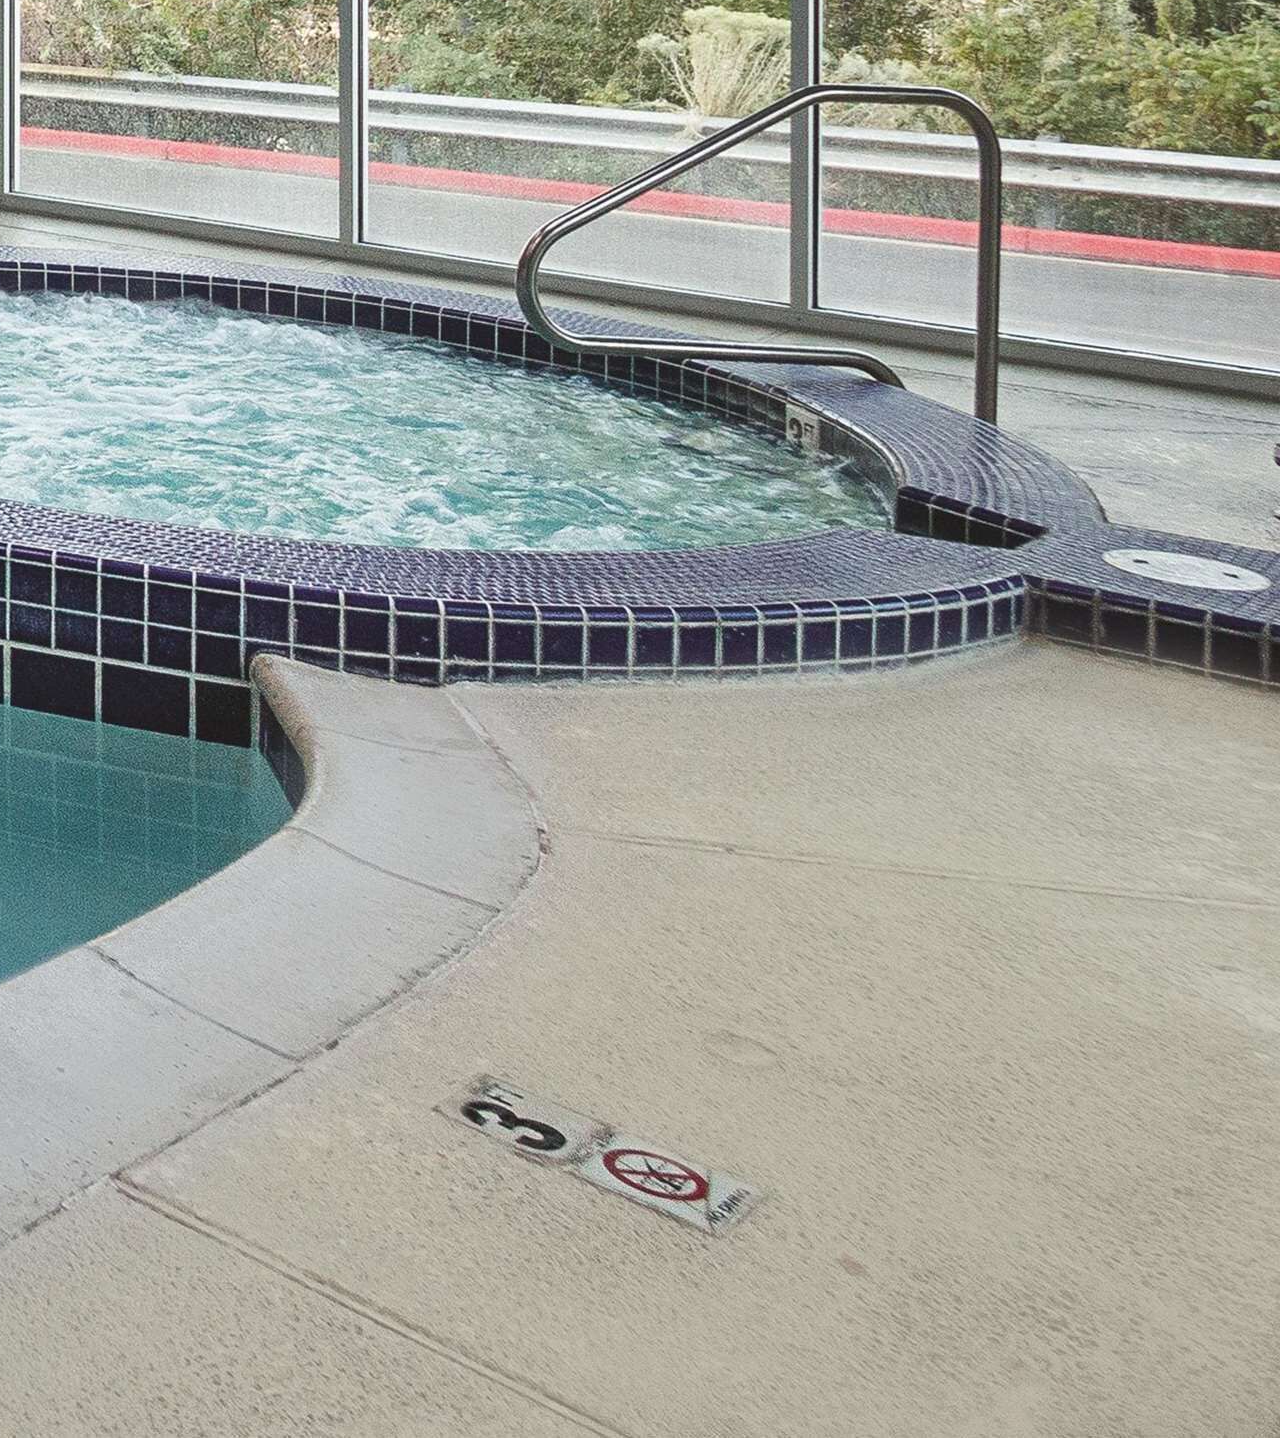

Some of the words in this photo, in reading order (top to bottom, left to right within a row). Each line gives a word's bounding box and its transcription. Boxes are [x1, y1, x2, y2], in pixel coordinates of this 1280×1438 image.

[803, 423, 815, 437] FT
[482, 1083, 524, 1107] FT
[460, 1101, 567, 1151] 3
